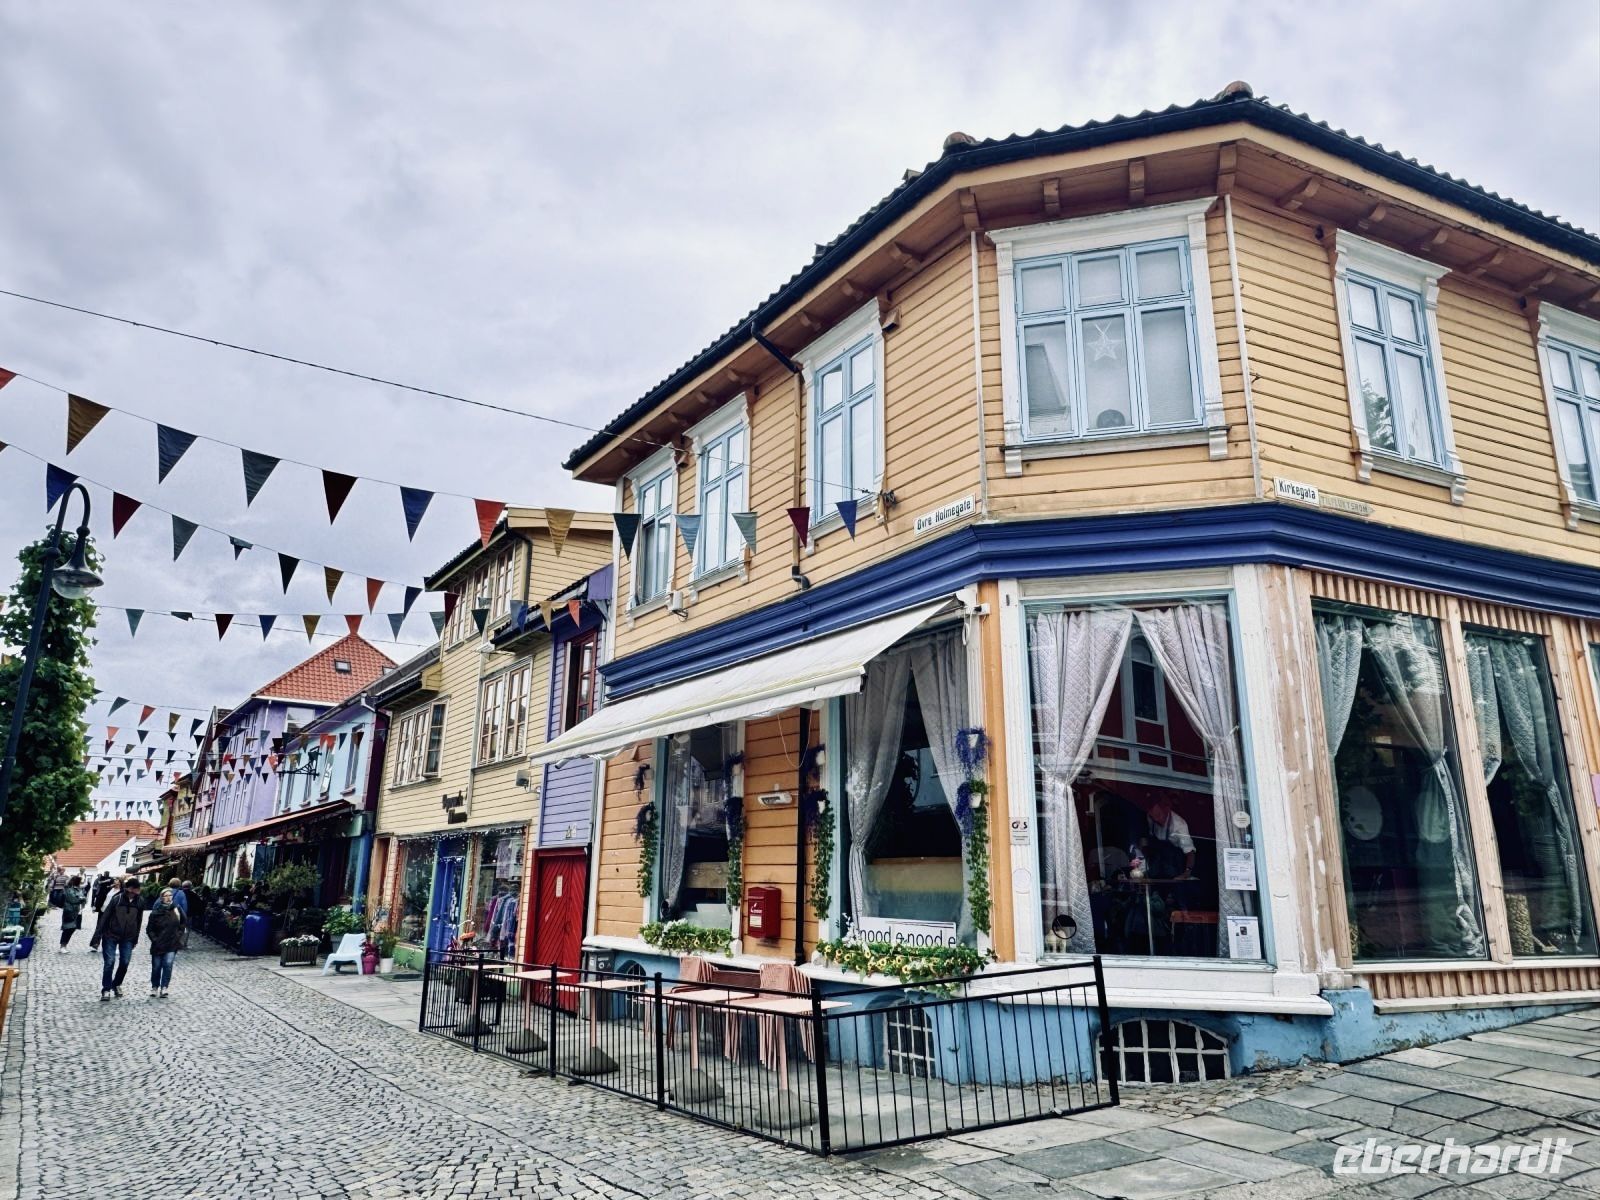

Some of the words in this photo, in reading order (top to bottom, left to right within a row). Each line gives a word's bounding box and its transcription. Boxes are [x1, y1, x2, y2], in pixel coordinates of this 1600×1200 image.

[1279, 480, 1316, 500] Kirkegata
[935, 500, 971, 522] Holmegate
[908, 929, 956, 949] noode
